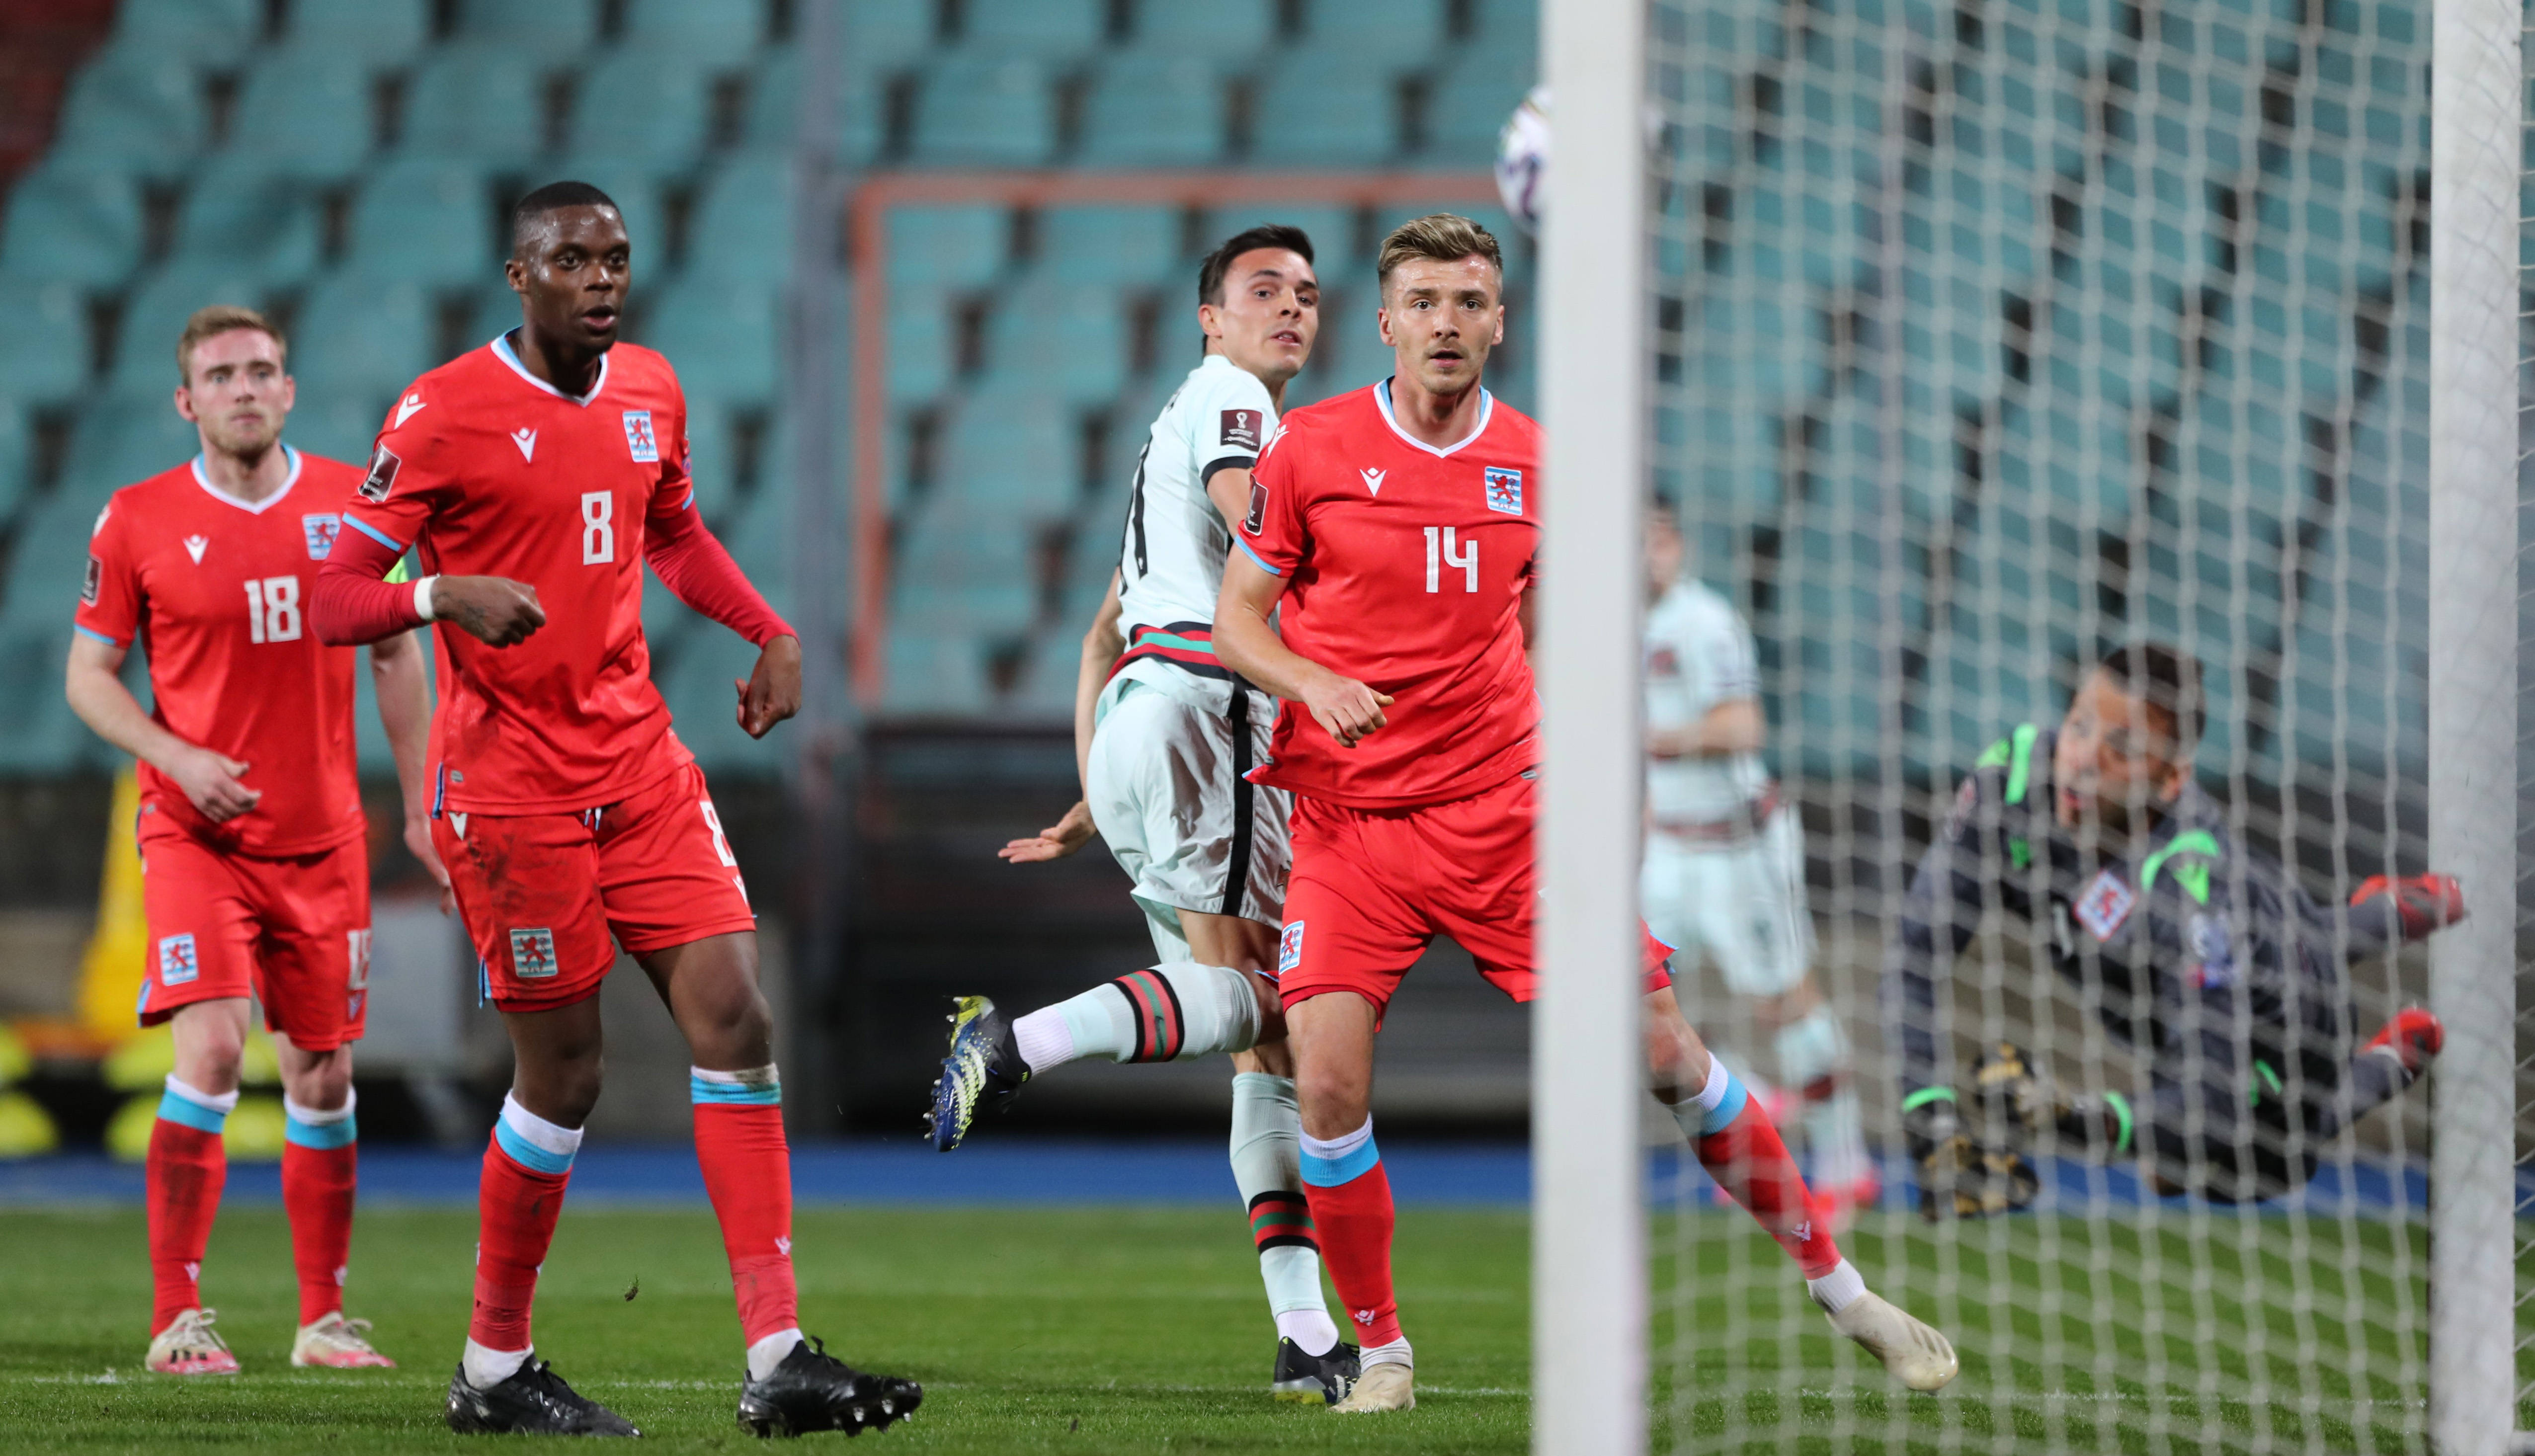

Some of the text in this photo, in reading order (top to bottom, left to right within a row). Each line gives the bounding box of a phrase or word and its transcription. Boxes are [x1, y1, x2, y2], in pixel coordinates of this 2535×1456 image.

[581, 490, 614, 566] 8
[1424, 527, 1478, 593] 14
[244, 575, 301, 644] 18
[699, 801, 737, 867] 8
